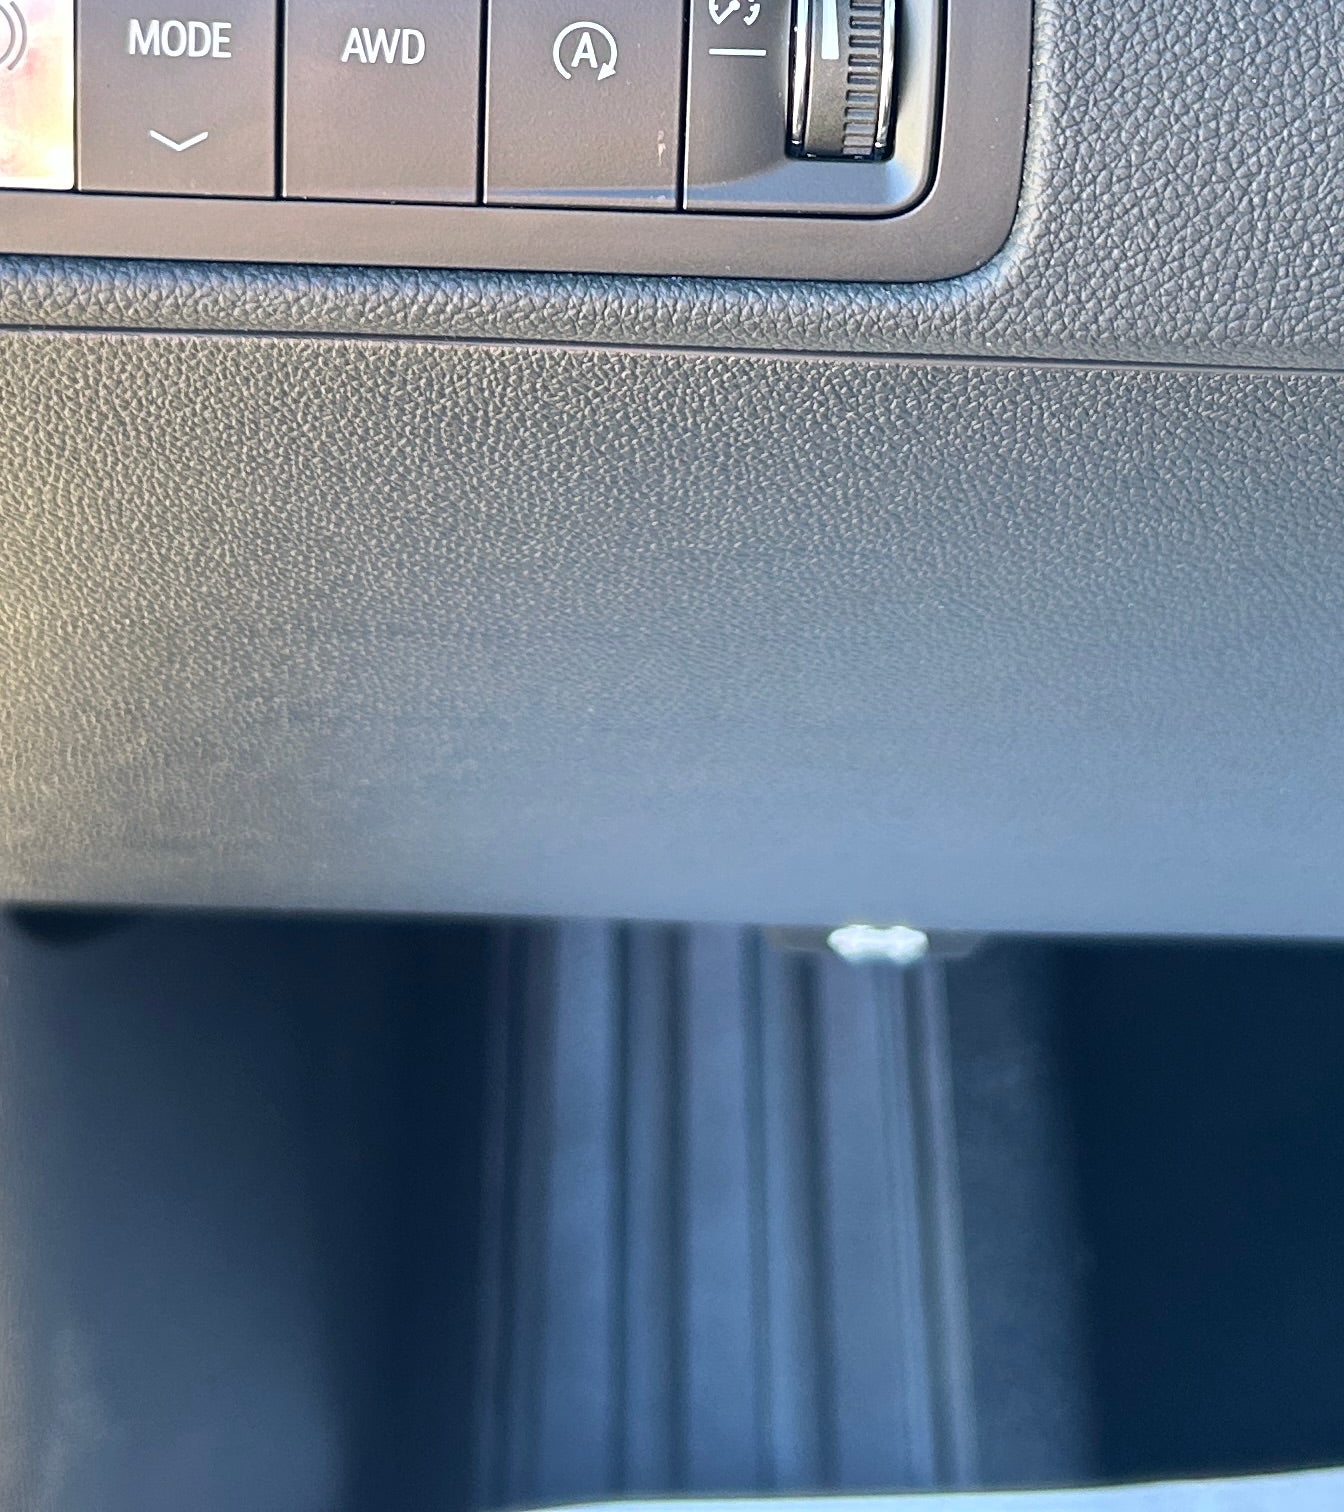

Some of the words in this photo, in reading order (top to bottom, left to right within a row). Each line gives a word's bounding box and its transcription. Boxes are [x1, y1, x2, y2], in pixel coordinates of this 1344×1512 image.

[128, 18, 232, 59] MODE
[340, 27, 426, 65] AWD
[570, 31, 599, 69] A
